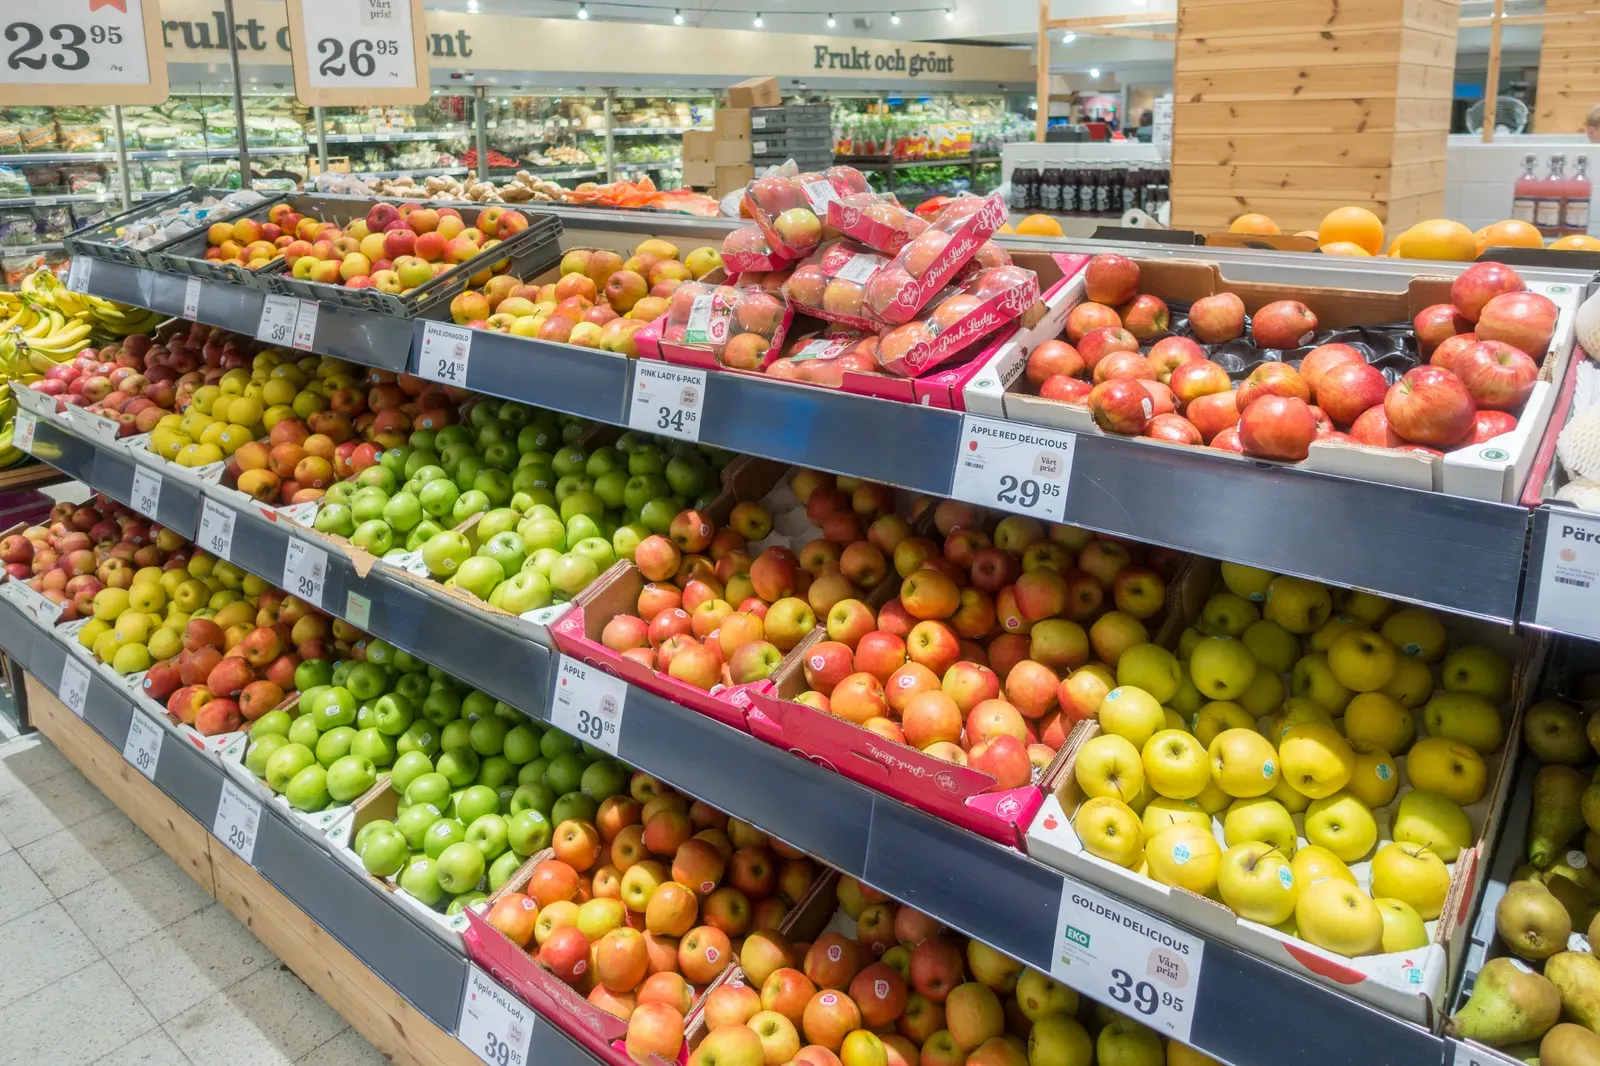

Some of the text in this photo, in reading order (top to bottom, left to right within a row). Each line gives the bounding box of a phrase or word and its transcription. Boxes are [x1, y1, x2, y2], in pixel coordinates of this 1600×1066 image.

[370, 10, 392, 19] pris!
[161, 11, 267, 51] rukt
[4, 22, 90, 70] 23
[317, 38, 376, 77] 26
[814, 45, 954, 77] Frukt och grönt
[923, 238, 977, 290] Pink Lady
[271, 324, 286, 341] 39
[935, 312, 998, 353] Pink Lady
[437, 359, 456, 380] 24
[640, 368, 702, 386] PINK LADY 6-PACK
[657, 406, 697, 432] 34 95
[970, 424, 1068, 450] ÄPPLE RED DELICIOUS
[1040, 465, 1056, 473] pris!
[1041, 457, 1057, 466] Vårt
[997, 475, 1060, 508] 29 95
[211, 534, 224, 552] 49
[298, 576, 314, 597] 29
[563, 662, 586, 680] ÄPPLE
[577, 709, 615, 740] 39 95
[136, 747, 150, 769] 39
[228, 824, 245, 849] 29
[1067, 928, 1088, 945] EKO
[1071, 894, 1121, 924] GOLDEN
[1122, 917, 1190, 955] DELICIOUS
[1156, 964, 1178, 981] pris!
[1158, 954, 1179, 971] Vårt
[472, 976, 524, 1023] Äpple Pink Lady
[1108, 968, 1184, 1015] 39 95
[485, 1032, 522, 1066] 39 95
